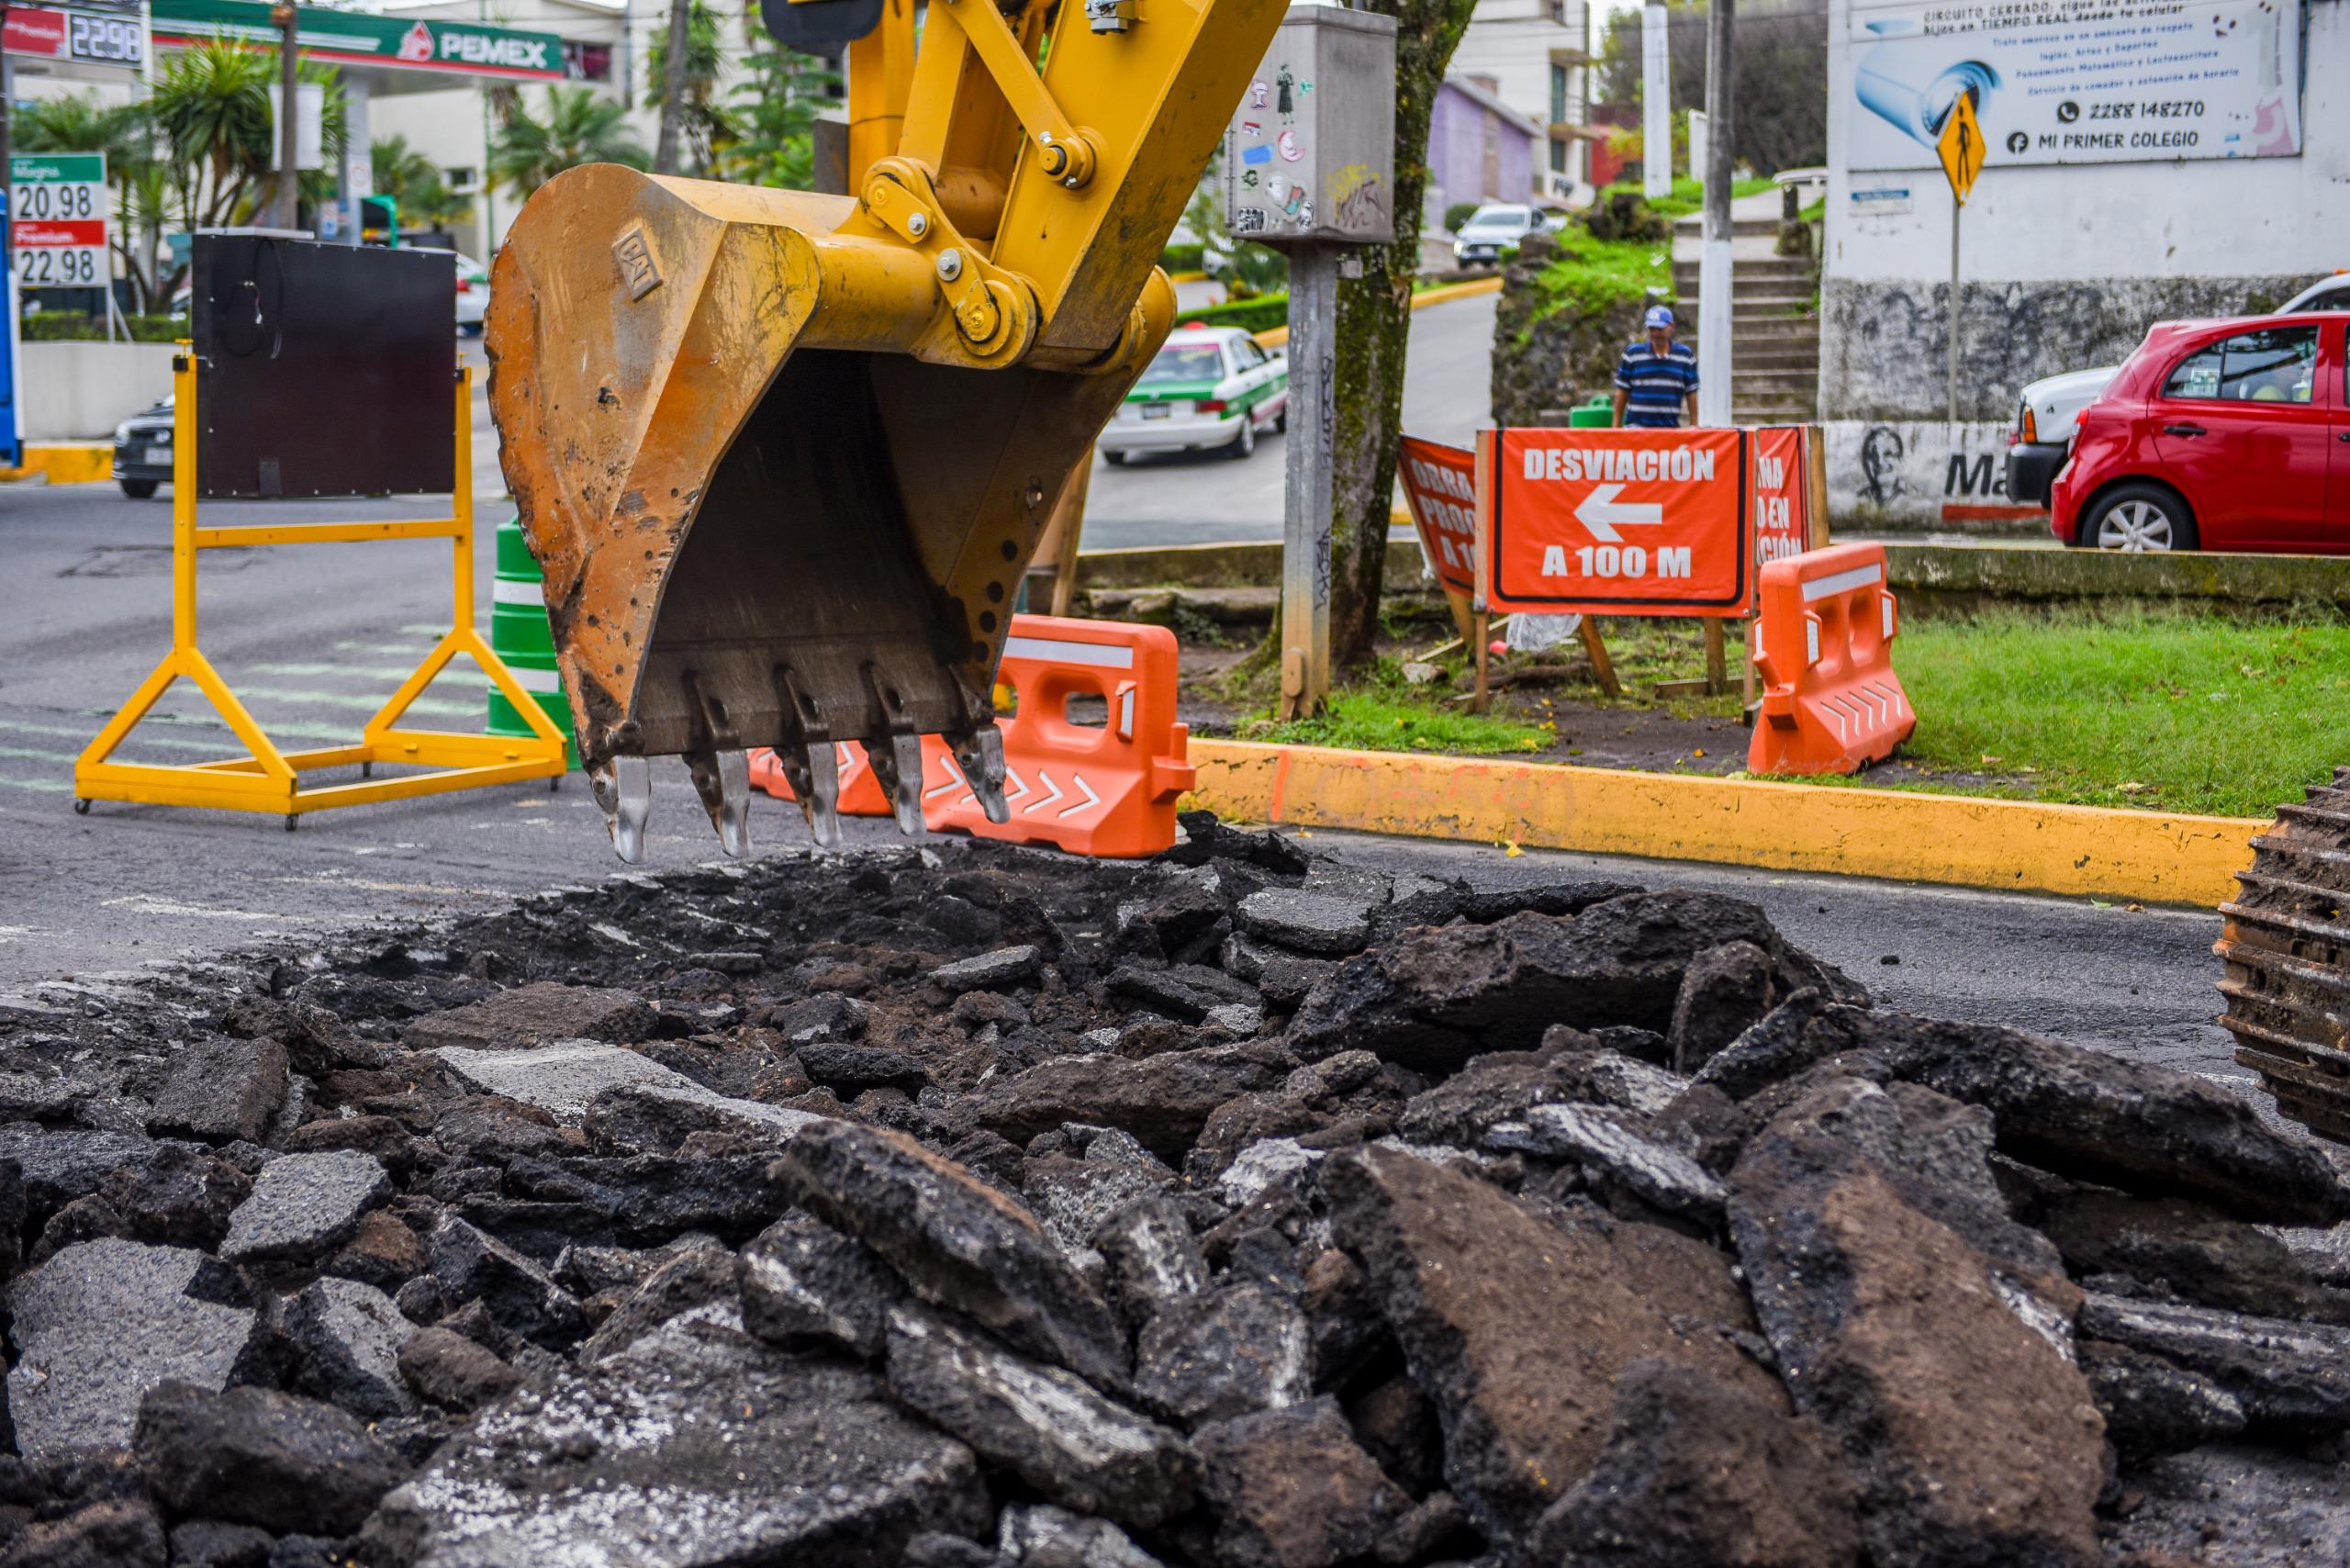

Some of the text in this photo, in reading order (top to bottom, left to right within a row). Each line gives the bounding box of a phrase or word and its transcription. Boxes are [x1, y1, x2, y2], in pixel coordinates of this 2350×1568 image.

[1923, 7, 1983, 23] CIRCUITO
[1982, 15, 2031, 30] TIEMPO
[2036, 12, 2070, 26] REAL
[2139, 5, 2184, 17] celular
[440, 32, 548, 70] PEMEX
[2088, 100, 2206, 120] 2288 148270
[2038, 130, 2199, 150] MI PRIMER COLEGIO
[14, 166, 61, 181] Magna
[1523, 443, 1715, 482] DESVIACIÓN
[1410, 457, 1476, 504] OBRA
[1768, 496, 1790, 530] EN
[1440, 535, 1461, 569] A
[1541, 544, 1692, 579] A 100 M
